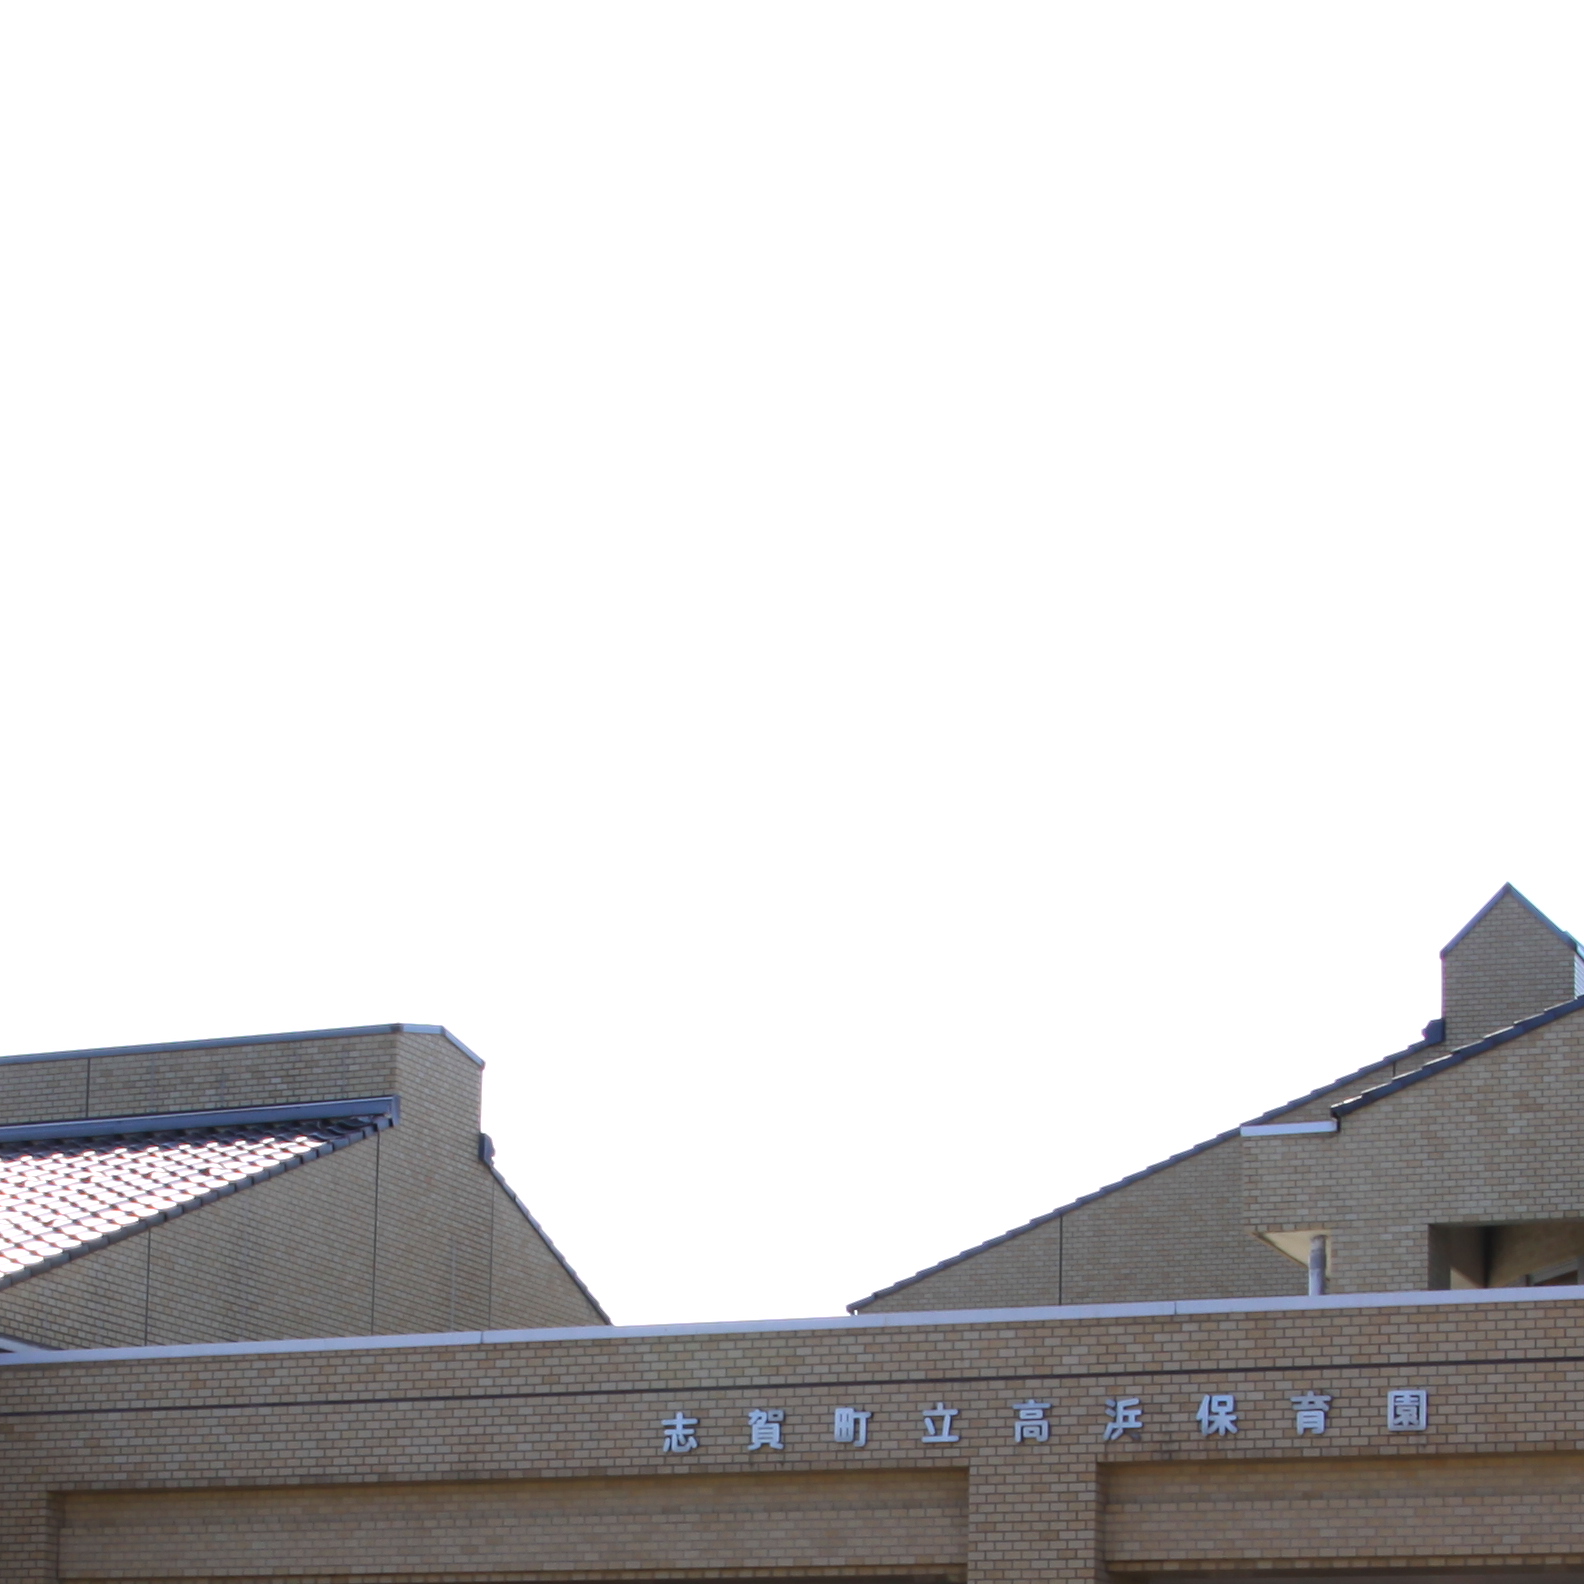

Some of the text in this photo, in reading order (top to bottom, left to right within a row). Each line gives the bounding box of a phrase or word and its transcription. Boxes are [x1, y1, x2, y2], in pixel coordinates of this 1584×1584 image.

[661, 1389, 1428, 1454] 志賀町立高浜保育園
